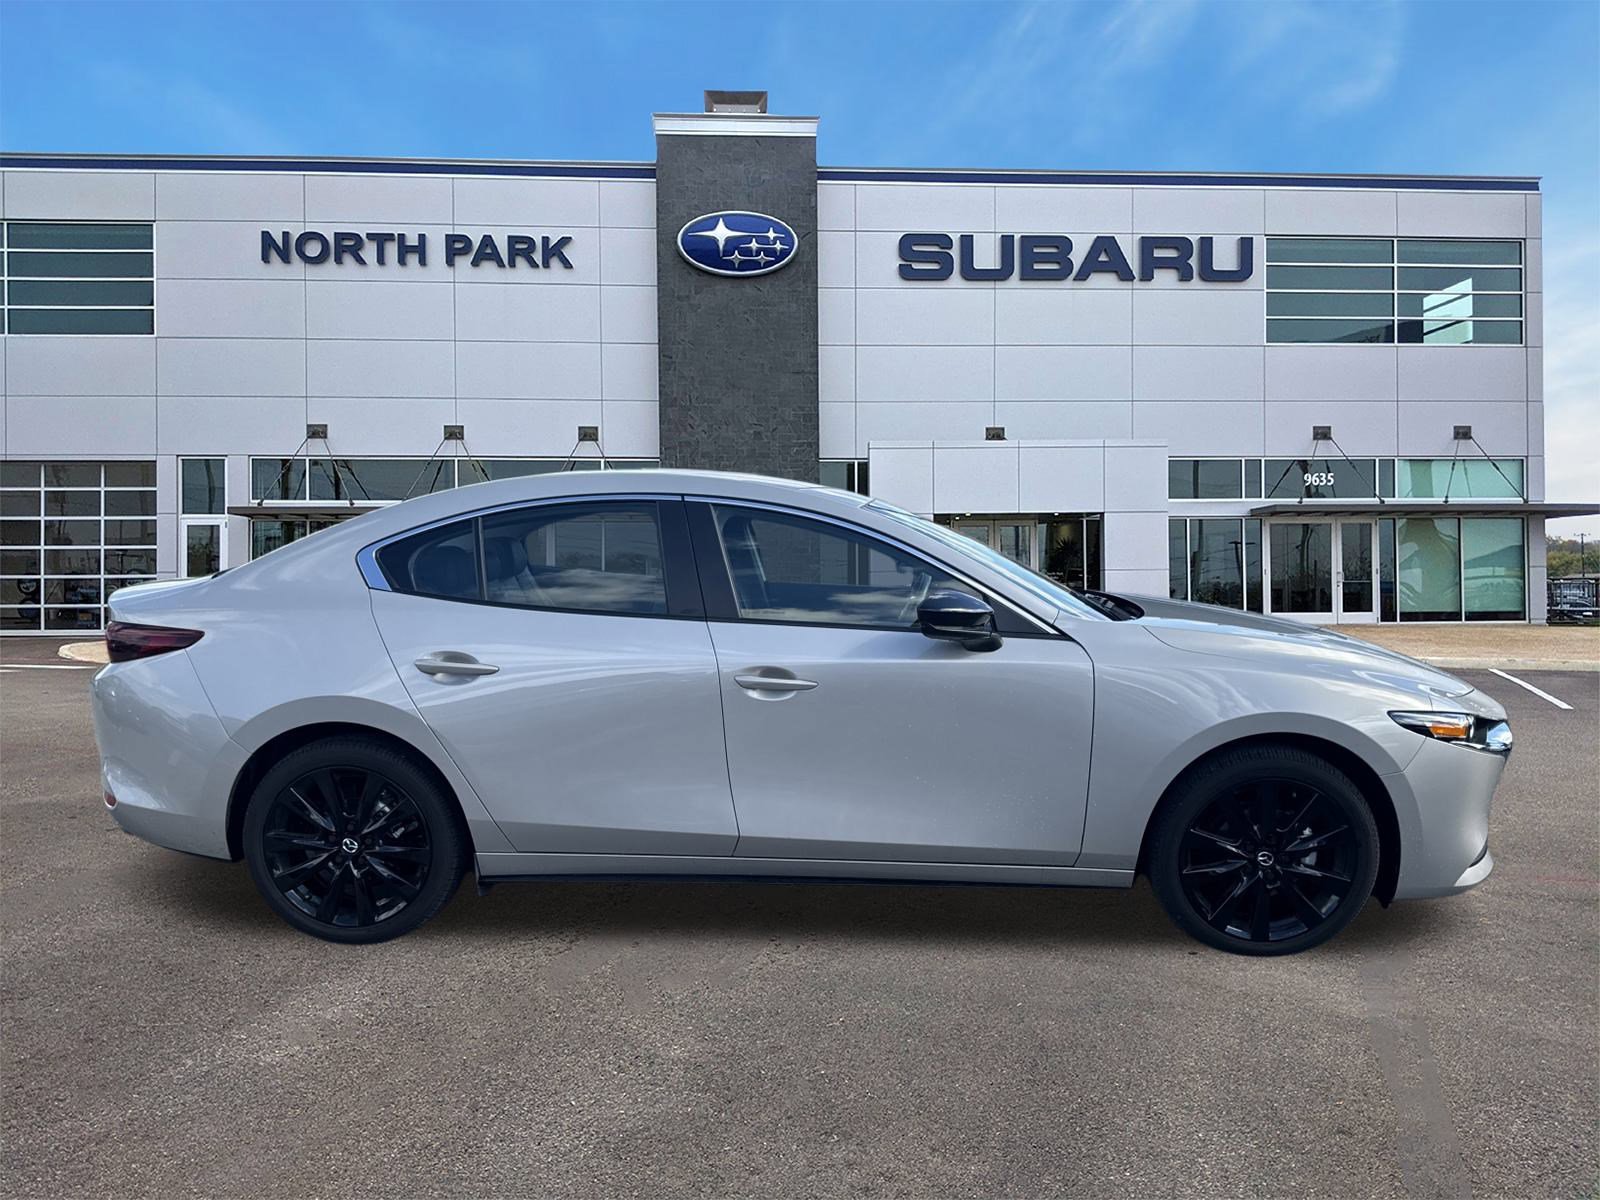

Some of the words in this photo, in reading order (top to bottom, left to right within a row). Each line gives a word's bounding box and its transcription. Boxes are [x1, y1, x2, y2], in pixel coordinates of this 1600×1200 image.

[260, 230, 427, 266] NORTH
[445, 233, 574, 269] PARK
[898, 232, 1254, 282] SUBARU
[1303, 472, 1335, 486] 9635
